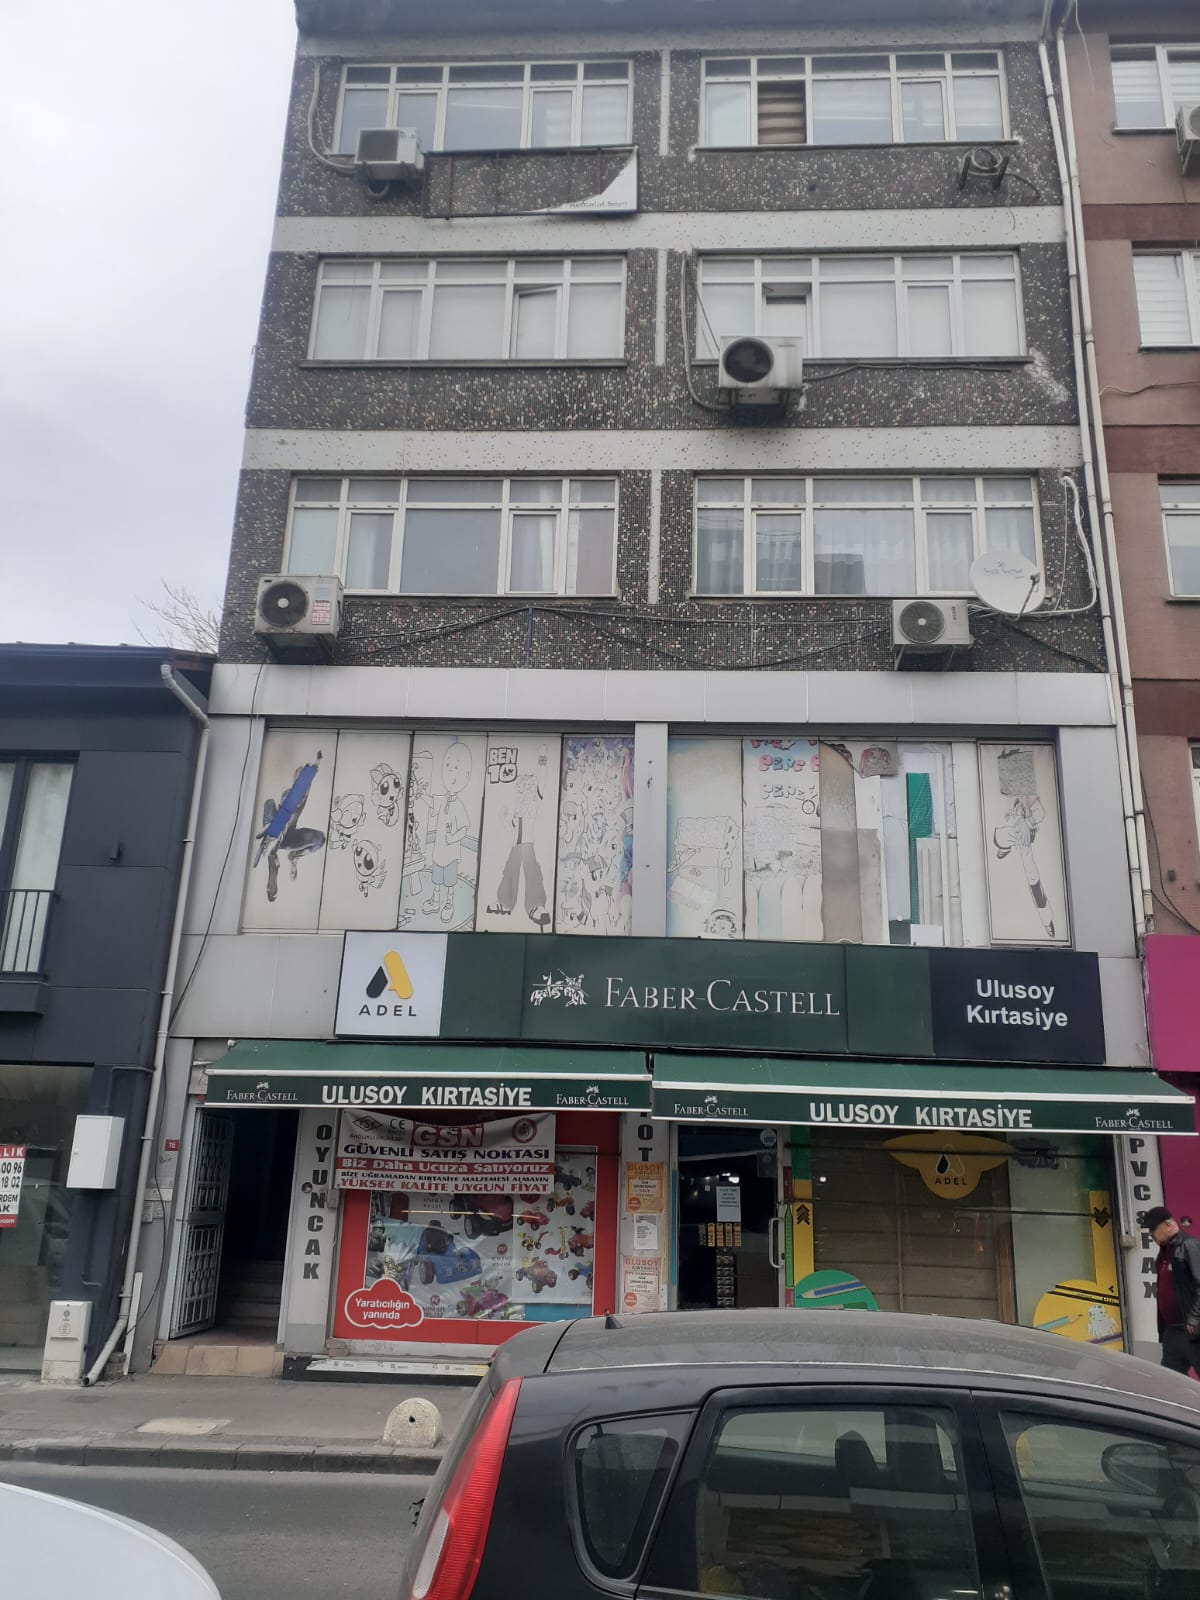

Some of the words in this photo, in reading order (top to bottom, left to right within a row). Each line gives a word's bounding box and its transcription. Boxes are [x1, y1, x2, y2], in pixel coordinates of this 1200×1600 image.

[489, 747, 518, 765] BEN
[488, 763, 518, 784] 10
[976, 979, 1055, 1005] Ulusoy
[358, 1004, 417, 1017] ADEL
[966, 1004, 1068, 1031] Kırtasiye
[322, 1085, 408, 1104] ULUSOY
[421, 1082, 532, 1106] KIRTASİYE
[809, 1102, 899, 1124] ULUSOY
[915, 1103, 1033, 1128] KIRTASİYE
[413, 1126, 483, 1147] GSN
[420, 1147, 468, 1161] SATIŞ
[473, 1148, 550, 1160] NOKTASI
[342, 1158, 367, 1169] Biz
[372, 1159, 413, 1172] Daha
[418, 1162, 468, 1173] Ucuza
[473, 1162, 549, 1174] Satıyoruz
[341, 1178, 395, 1189] YÜKSEK
[400, 1180, 449, 1192] KALİTE
[454, 1183, 505, 1193] UYGUN
[510, 1181, 550, 1193] FİYAT
[934, 1176, 968, 1186] ADEL
[302, 1124, 333, 1280] OYUNCAK
[355, 1298, 410, 1311] Yaratıcılığın
[363, 1310, 401, 1320] yanında
